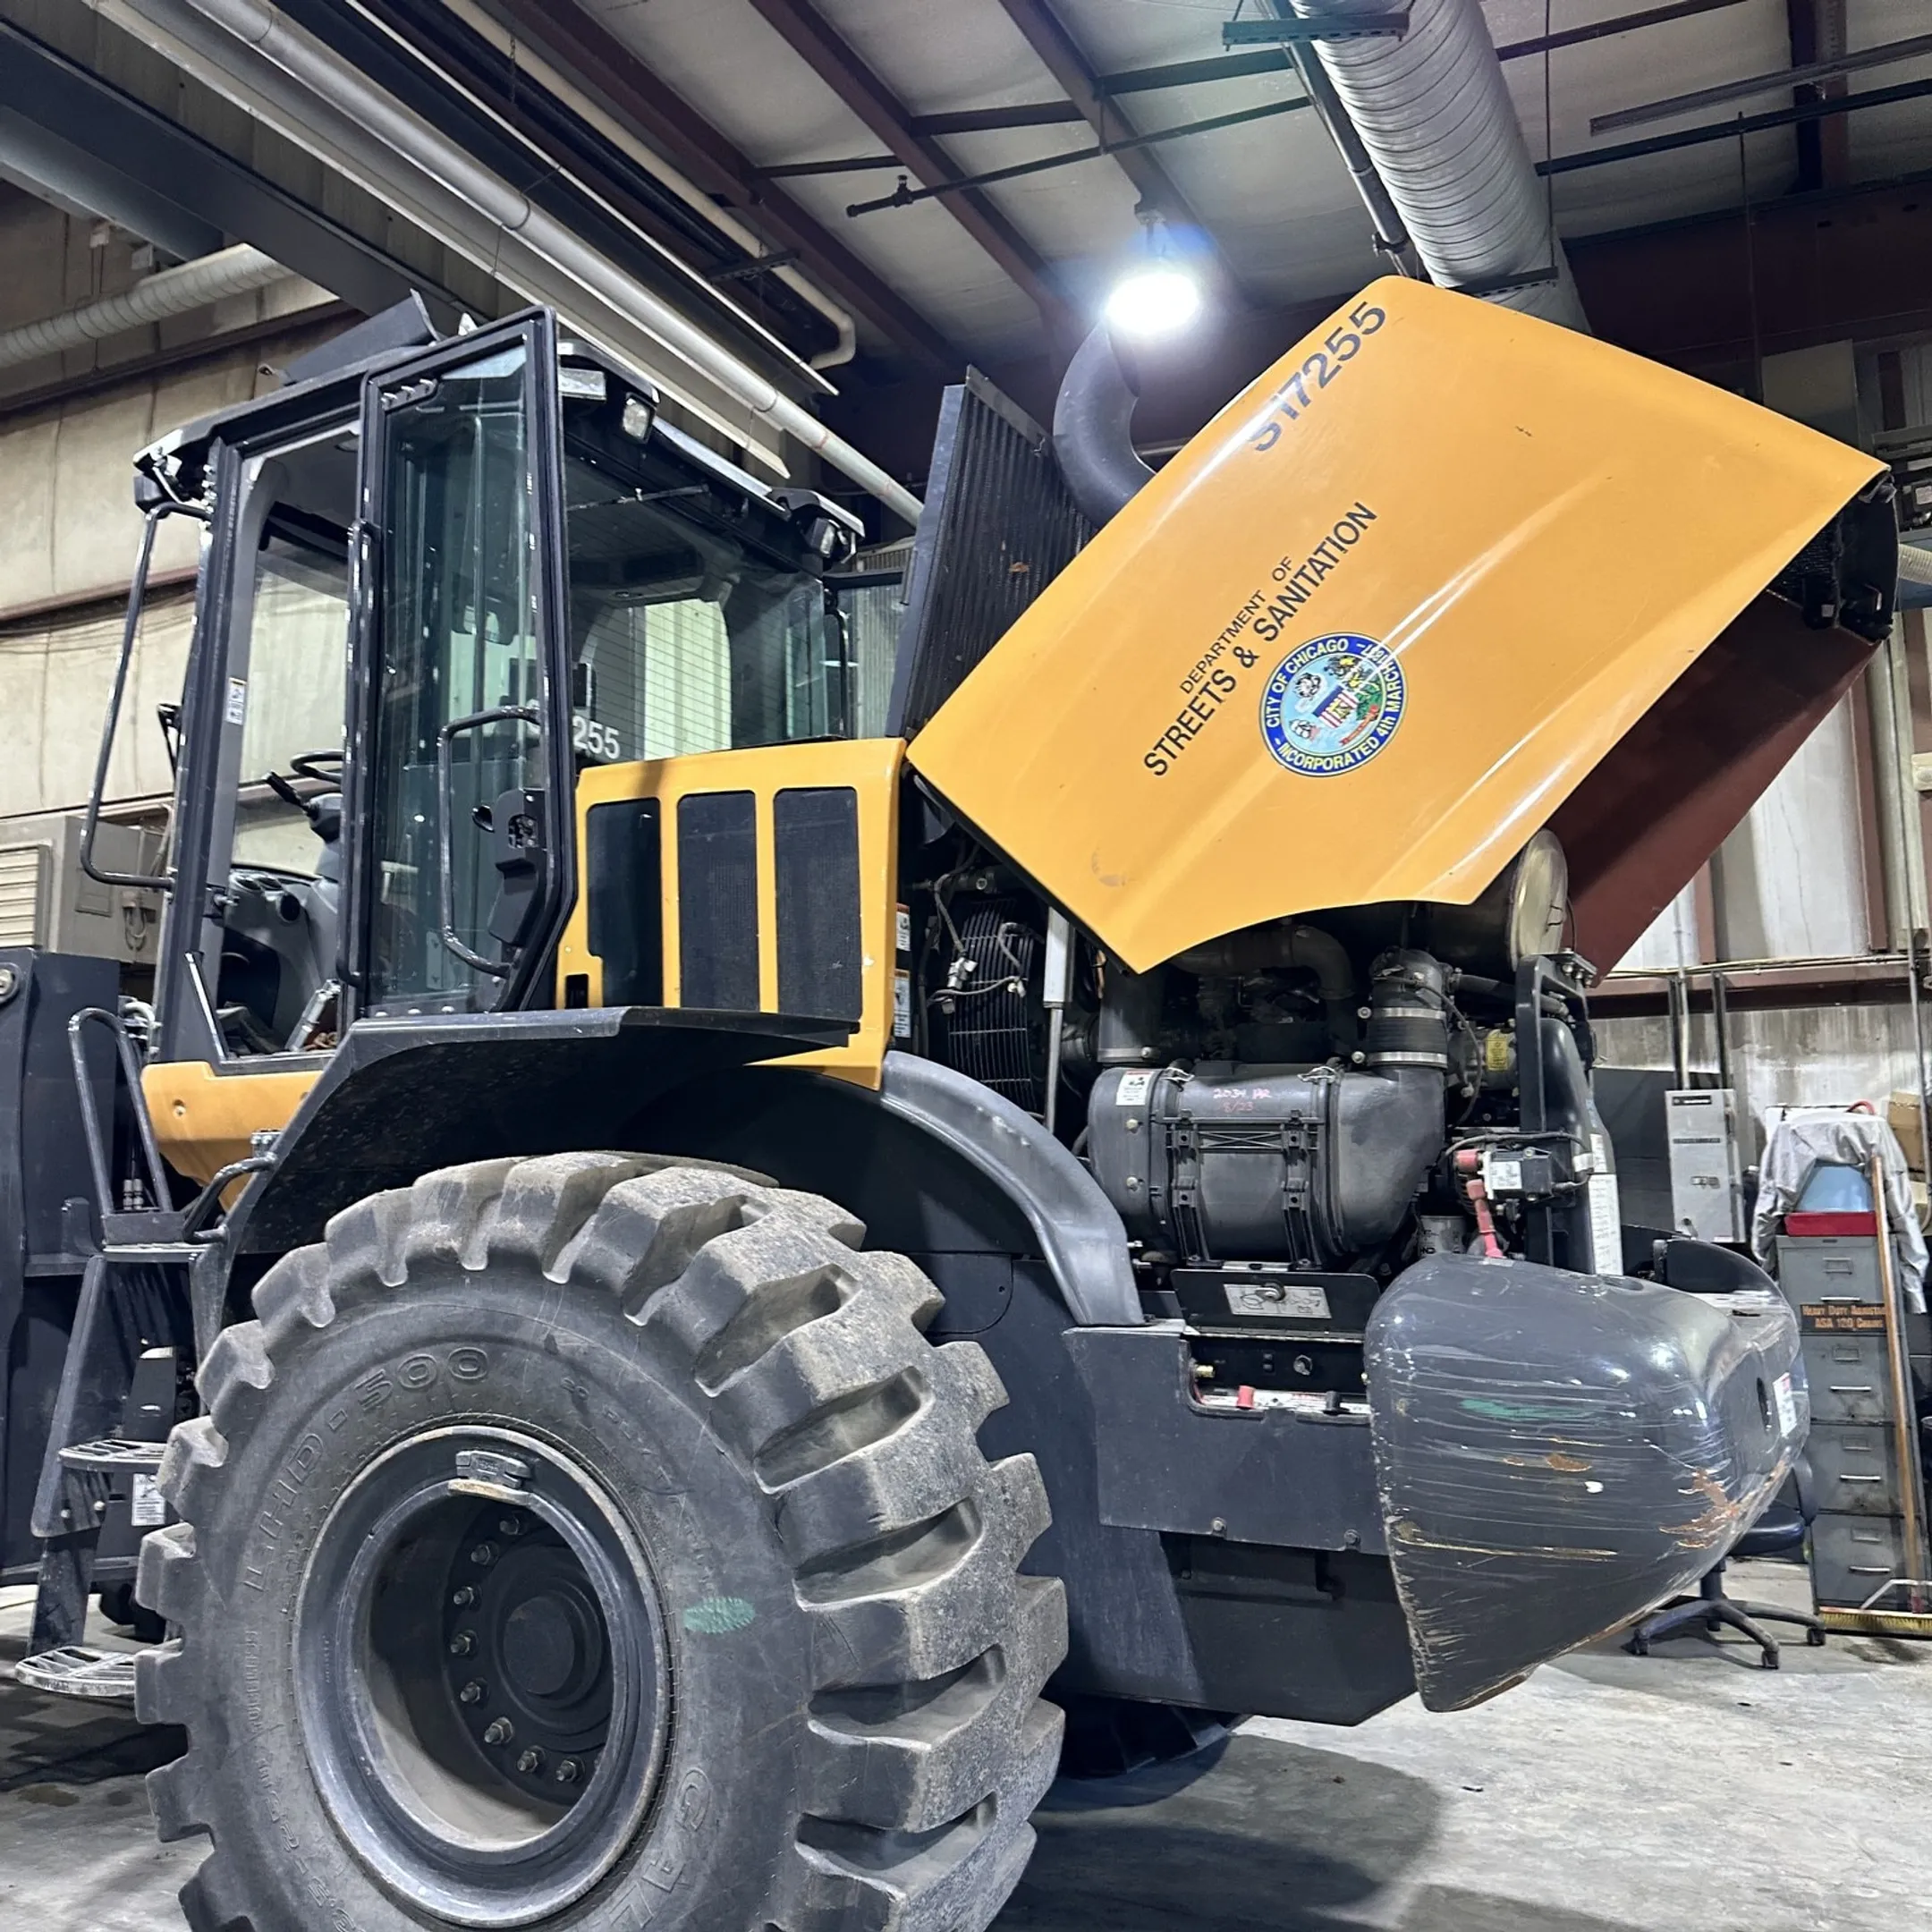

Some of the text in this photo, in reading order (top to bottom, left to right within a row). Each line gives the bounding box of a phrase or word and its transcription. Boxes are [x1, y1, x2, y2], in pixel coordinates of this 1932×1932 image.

[1144, 502, 1377, 776] STREETS & SANITATION
[1180, 556, 1293, 694] DEPARTMENT OF
[1266, 638, 1349, 727] CITY OF CHICAGO
[1382, 661, 1402, 712] MARCH
[1278, 736, 1380, 771] INCORPORATED
[1376, 716, 1396, 736] 4th
